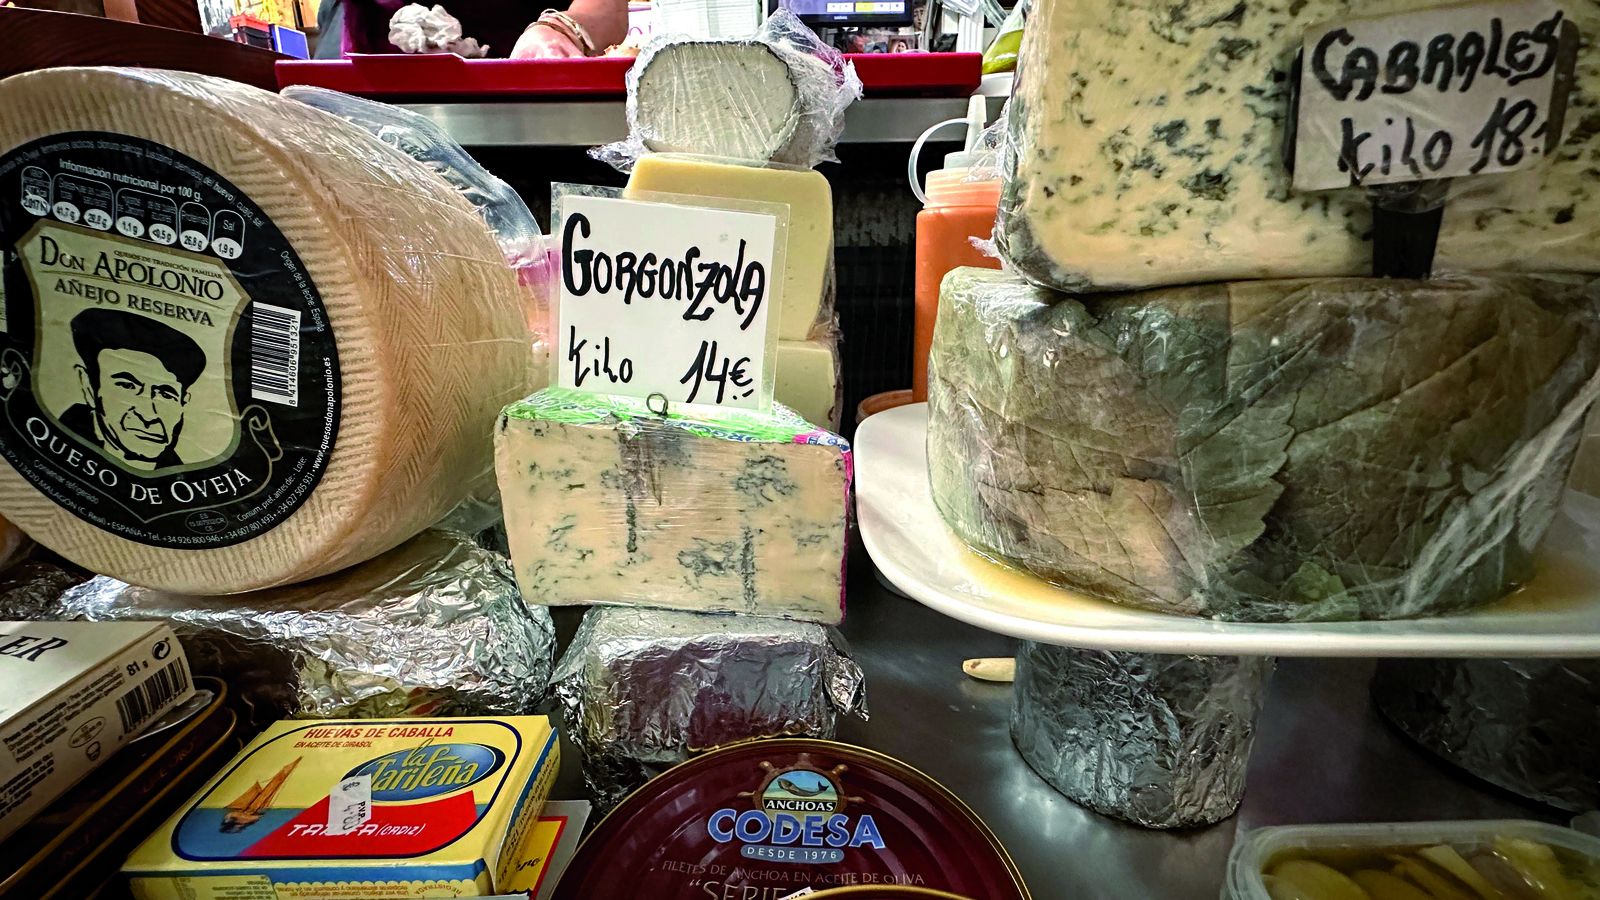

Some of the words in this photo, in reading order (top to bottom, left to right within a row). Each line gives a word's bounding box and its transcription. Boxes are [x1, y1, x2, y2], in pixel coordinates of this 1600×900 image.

[1312, 9, 1564, 101] CABRALES
[59, 158, 112, 179] Información
[113, 173, 159, 190] nutricional
[160, 184, 175, 196] por
[177, 186, 193, 198] 100
[223, 219, 236, 231] Sal
[93, 251, 224, 301] APOLONIO
[142, 255, 151, 263] DE
[191, 267, 223, 280] FAMILIAR
[280, 250, 297, 273] Origen
[293, 272, 303, 282] de
[562, 212, 765, 330] GORGONZOLA
[54, 278, 121, 305] AÑEJO
[126, 293, 215, 328] RESERVA
[26, 416, 118, 488] QUESO
[130, 482, 163, 505] DE
[170, 468, 253, 505] OVEJA
[111, 521, 143, 537] ESPAÑA
[177, 535, 192, 544] 926
[192, 535, 206, 544] 800
[205, 533, 220, 543] 946
[249, 520, 263, 531] 801
[277, 502, 289, 514] +34
[285, 493, 298, 506] 627
[294, 483, 308, 496] 505
[302, 471, 315, 486] 931
[312, 356, 336, 469] www.quesosdonapolonio.es
[273, 483, 289, 500] antes
[0, 634, 69, 662] ER
[126, 660, 141, 676] 81
[303, 728, 364, 739] HUEVAS
[364, 728, 386, 738] DE
[388, 726, 454, 738] CABALLA
[401, 737, 434, 767] la
[371, 746, 479, 793] Tarifeña
[765, 799, 834, 811] ANCHOAS
[707, 808, 886, 850] CODESA
[747, 847, 796, 860] DESDE
[804, 850, 838, 860] 1976
[662, 860, 707, 875] FILETES
[710, 864, 728, 876] DE
[732, 866, 789, 881] ANCHOA
[793, 871, 811, 882] EN
[815, 872, 858, 885] ACEITE
[862, 872, 880, 884] DE
